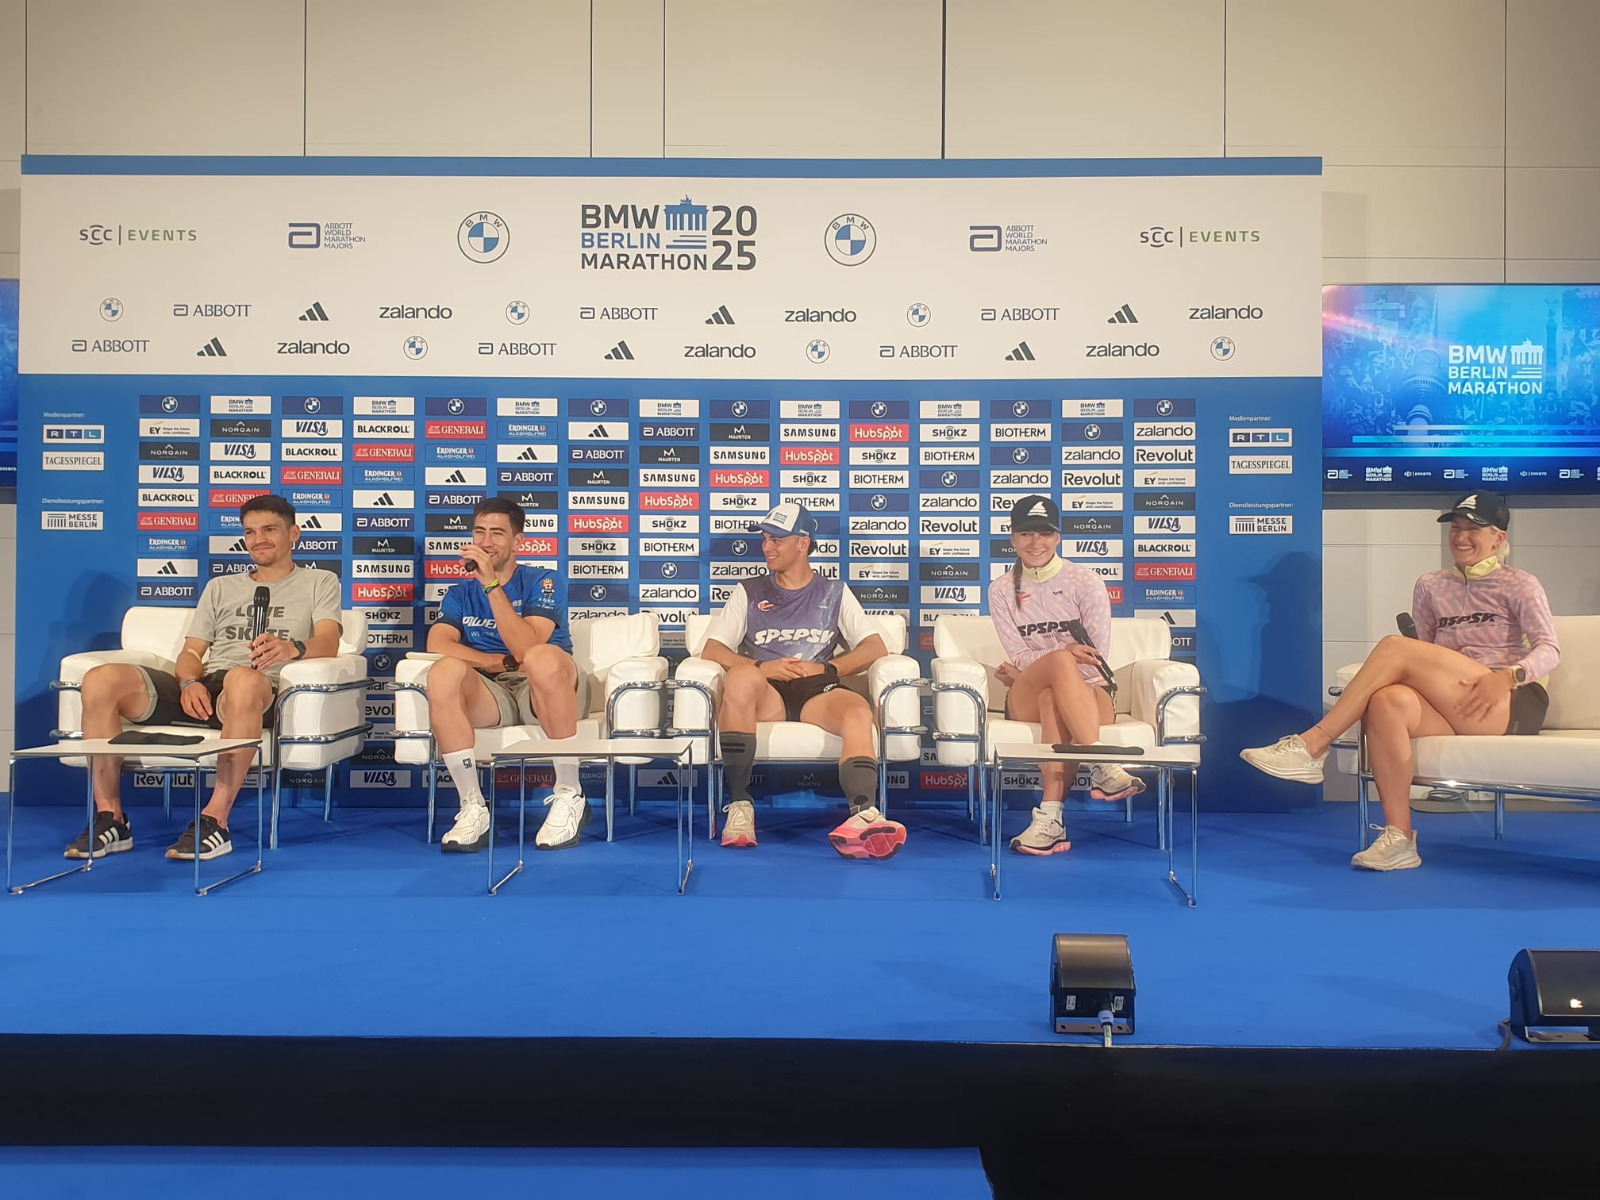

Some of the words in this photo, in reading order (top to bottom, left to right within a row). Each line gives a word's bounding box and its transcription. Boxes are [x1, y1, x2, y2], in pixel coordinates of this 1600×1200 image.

[581, 205, 659, 229] BMW
[712, 206, 757, 236] 20
[80, 225, 112, 244] SCC
[128, 229, 196, 241] EVENTS
[1140, 228, 1174, 247] SCC
[1189, 231, 1260, 242] EVENTS
[581, 233, 660, 248] BERLIN
[712, 240, 757, 270] 25
[581, 254, 707, 270] MARATHON
[194, 304, 251, 317] ABBOTT
[380, 304, 452, 319] zalando
[600, 308, 658, 320] ABBOTT
[785, 308, 856, 322] zalando
[1001, 308, 1060, 321] ABBOTT
[1189, 305, 1263, 320] zalando
[92, 340, 149, 352] ABBOTT
[278, 340, 350, 354] zalando
[498, 343, 557, 356] ABBOTT
[684, 344, 756, 358] zalando
[900, 345, 958, 358] ABBOTT
[1086, 343, 1159, 357] zalando
[1449, 346, 1507, 364] BMW
[1449, 367, 1508, 378] BERLIN
[1449, 382, 1542, 394] MARATHON
[295, 421, 328, 435] VILSA
[358, 425, 410, 433] BLACKROLL
[441, 426, 483, 434] GENERALI
[657, 427, 695, 436] ABBOTT
[783, 428, 836, 437] SAMSUNG
[855, 426, 902, 439] HubSpot
[932, 427, 967, 438] SHOKZ
[995, 428, 1046, 437] BIOTHERM
[1136, 425, 1192, 436] zalando
[224, 444, 256, 458] VILSA
[286, 448, 338, 456] BLACKROLL
[369, 448, 412, 457] GENERALI
[586, 450, 624, 459] ABBOTT
[714, 451, 766, 460] SAMSUNG
[786, 449, 833, 462] HubSpot
[862, 451, 896, 461] SHOKZ
[924, 452, 974, 461] BIOTHERM
[1064, 449, 1120, 460] zalando
[1136, 449, 1193, 461] Revolut
[44, 456, 102, 466] TAGESSPIEGEL
[1232, 461, 1290, 469] TAGESSPIEGEL
[152, 467, 184, 481] VILSA
[214, 470, 266, 478] BLACKROLL
[298, 471, 340, 480] GENERALI
[515, 473, 553, 482] ABBOTT
[643, 473, 696, 482] SAMSUNG
[715, 472, 763, 485] HubSpot
[854, 475, 903, 484] BIOTHERM
[993, 473, 1048, 484] zalando
[1064, 473, 1120, 485] Revolut
[143, 493, 194, 502] BLACKROLL
[443, 496, 482, 504] ABBOTT
[572, 496, 625, 504] SAMSUNG
[645, 494, 693, 508] HubSpot
[922, 497, 977, 508] zalando
[153, 517, 196, 525] GENERALI
[371, 518, 410, 527] ABBOTT
[574, 517, 622, 530] HubSpot
[652, 518, 687, 529] SHOKZ
[852, 520, 906, 531] zalando
[922, 520, 977, 532] Revolut
[1148, 517, 1181, 532] VILSA
[298, 540, 337, 550] ABBOTT
[581, 542, 616, 552] SHOKZ
[644, 543, 694, 552] BIOTHERM
[851, 543, 906, 555] Revolut
[1076, 541, 1108, 555] VILSA
[1138, 544, 1191, 552] BLACKROLL
[356, 564, 410, 573] SAMSUNG
[573, 565, 623, 574] BIOTHERM
[712, 564, 767, 577] zalando
[859, 570, 869, 578] EY
[1150, 567, 1193, 576] GENERALI
[155, 586, 193, 596] ABBOTT
[358, 586, 407, 599] HubSpot
[642, 587, 696, 598] zalando
[934, 587, 966, 601] VILSA
[366, 610, 400, 621] SHOKZ
[226, 626, 294, 642] SKTE.
[368, 634, 408, 644] OTHERM
[364, 772, 396, 786] VILSA
[1004, 775, 1039, 786] SHOKZ
